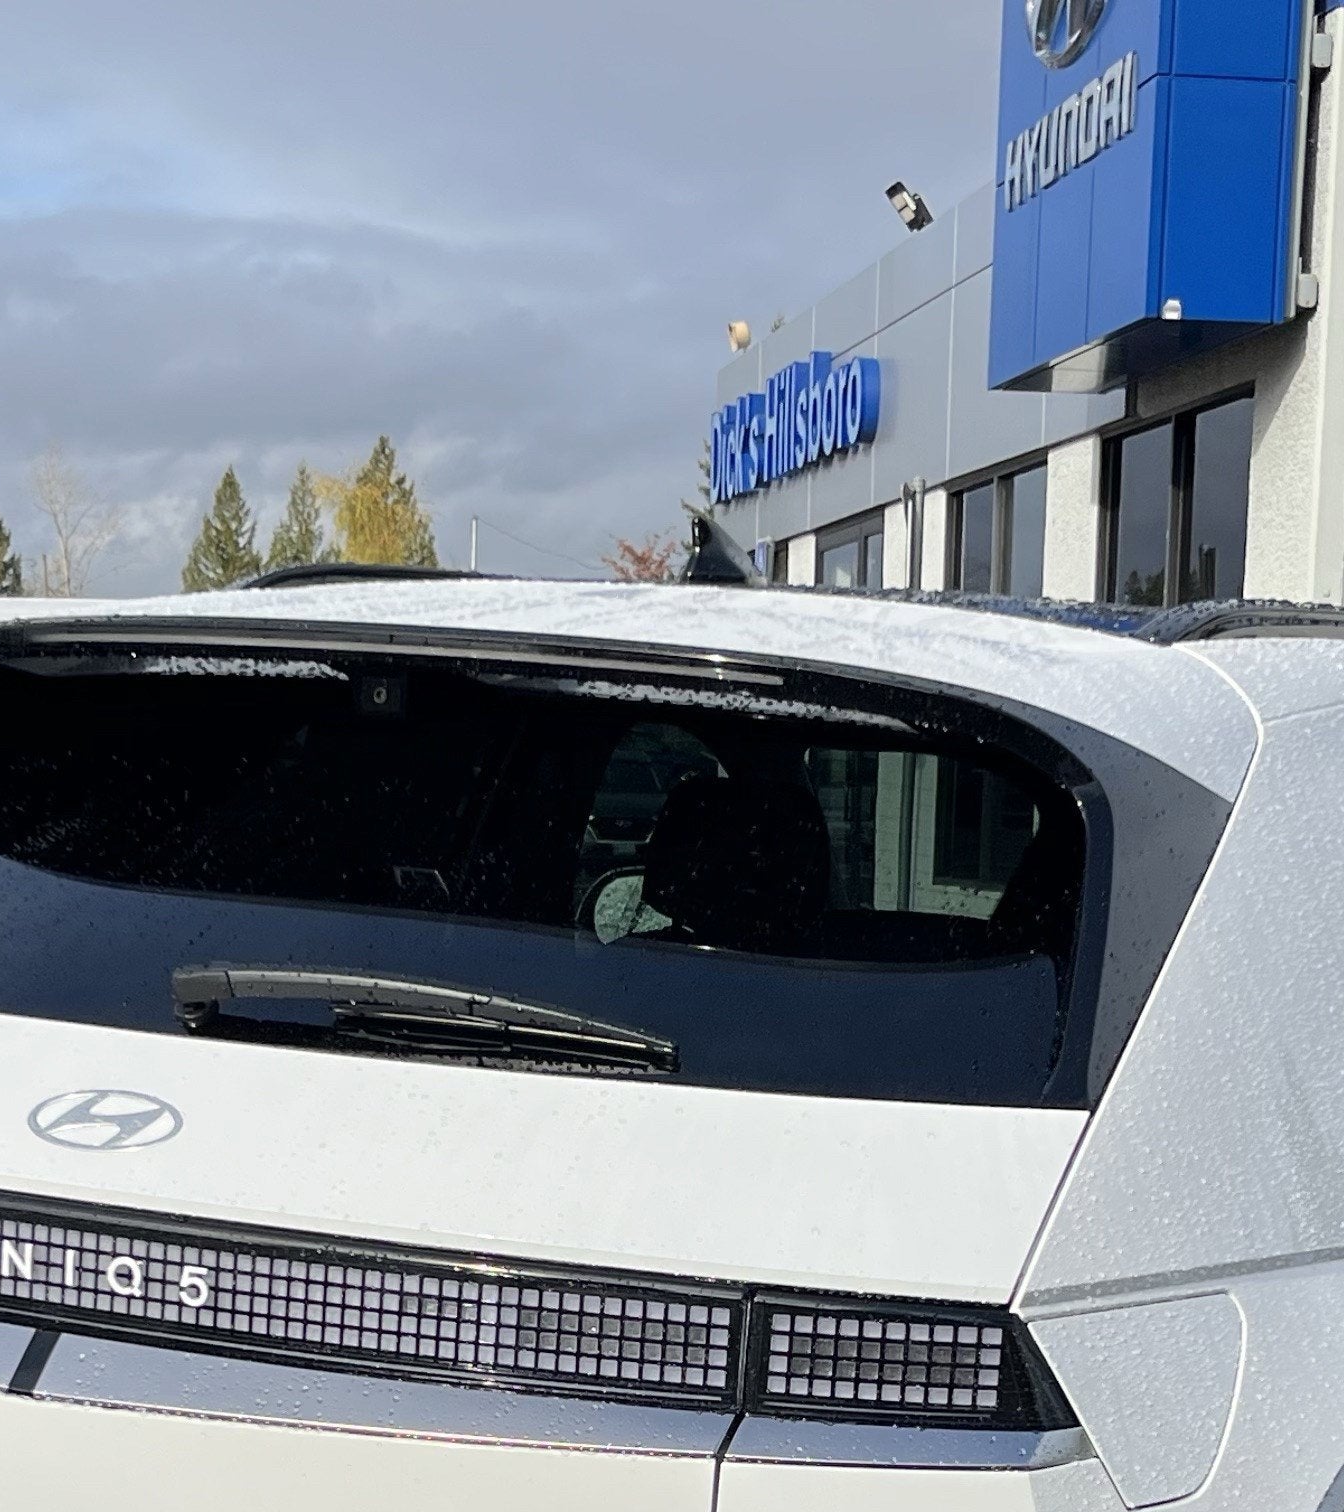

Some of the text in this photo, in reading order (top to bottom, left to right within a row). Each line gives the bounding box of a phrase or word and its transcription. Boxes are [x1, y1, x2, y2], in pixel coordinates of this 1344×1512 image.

[1006, 50, 1137, 213] HYUNDAI
[710, 352, 872, 504] Dick's Hillsboro
[179, 1266, 208, 1307] 5
